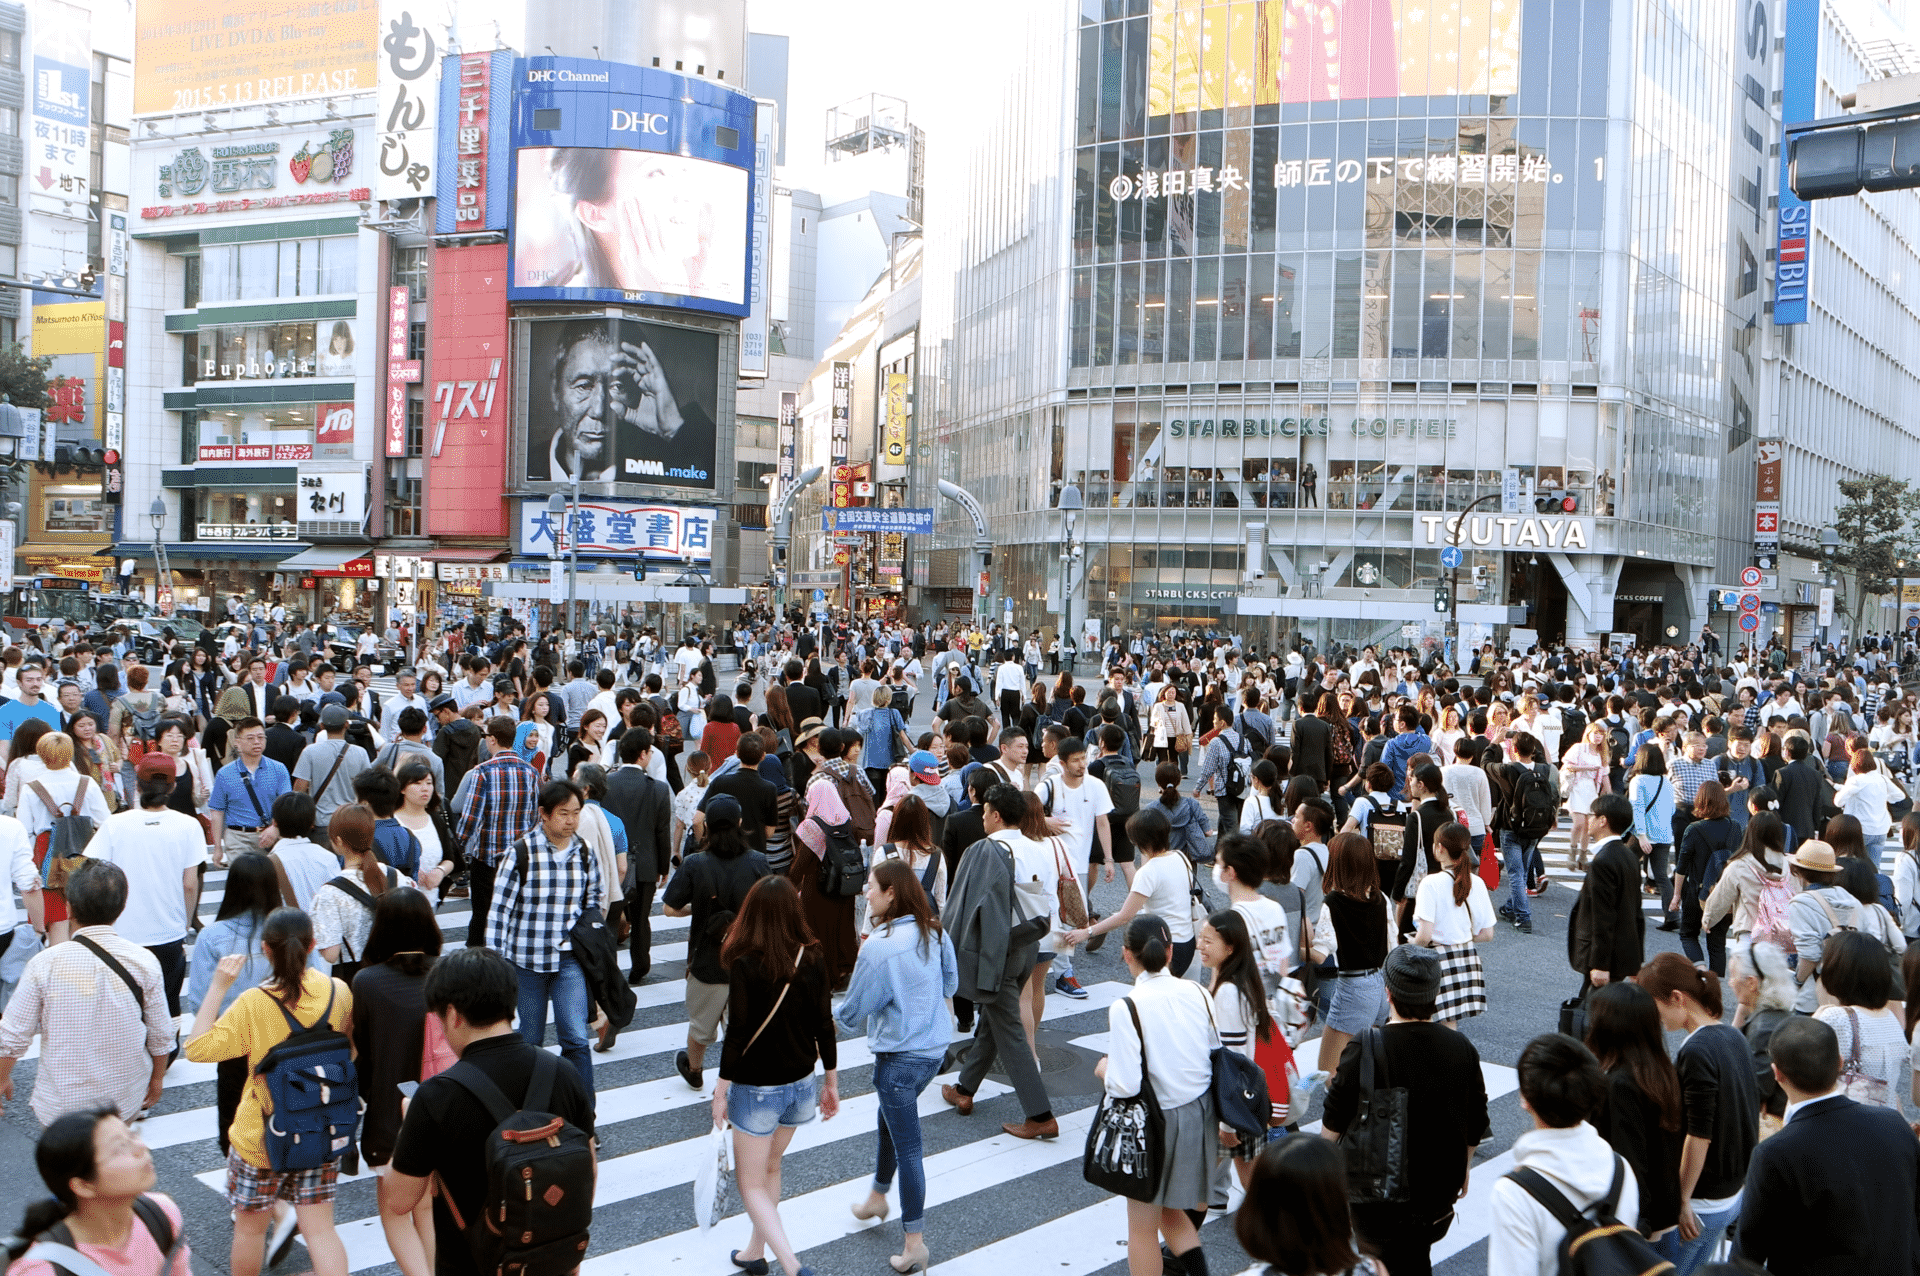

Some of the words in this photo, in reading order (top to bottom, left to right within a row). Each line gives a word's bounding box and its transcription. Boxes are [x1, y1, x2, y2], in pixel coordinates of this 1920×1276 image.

[190, 33, 227, 52] LIVE
[228, 28, 264, 47] DVD
[264, 29, 276, 44] &
[528, 69, 556, 83] DHC
[558, 70, 609, 83] Channel
[172, 81, 254, 110] 2015.5.13
[258, 68, 359, 101] RELEASE
[382, 10, 435, 192] もんじゃ
[611, 109, 669, 136] DHC
[35, 120, 86, 148] 夜11時
[456, 58, 486, 222] 三千里薬品
[45, 144, 76, 165] まで
[60, 173, 86, 194] 地下
[625, 291, 646, 302] DHC
[36, 314, 80, 325] Matsumoto
[744, 342, 762, 350] 3719
[746, 332, 761, 342] (03)
[205, 356, 309, 381] Euphoria
[430, 358, 502, 457] クスリ
[833, 366, 849, 459] 洋服の青山
[319, 408, 354, 435] JTB
[1170, 417, 1332, 438] STARBUCKS
[1351, 417, 1458, 438] COFFEE
[238, 447, 271, 459] 海外旅行
[890, 445, 902, 455] 4F
[625, 457, 707, 480] DMM.make
[530, 511, 707, 549] 大盛堂書店
[1421, 514, 1588, 549] TSUTAYA
[1759, 515, 1776, 531] 本
[443, 567, 503, 579] 三千里薬品
[1145, 589, 1208, 599] STARBUCKS
